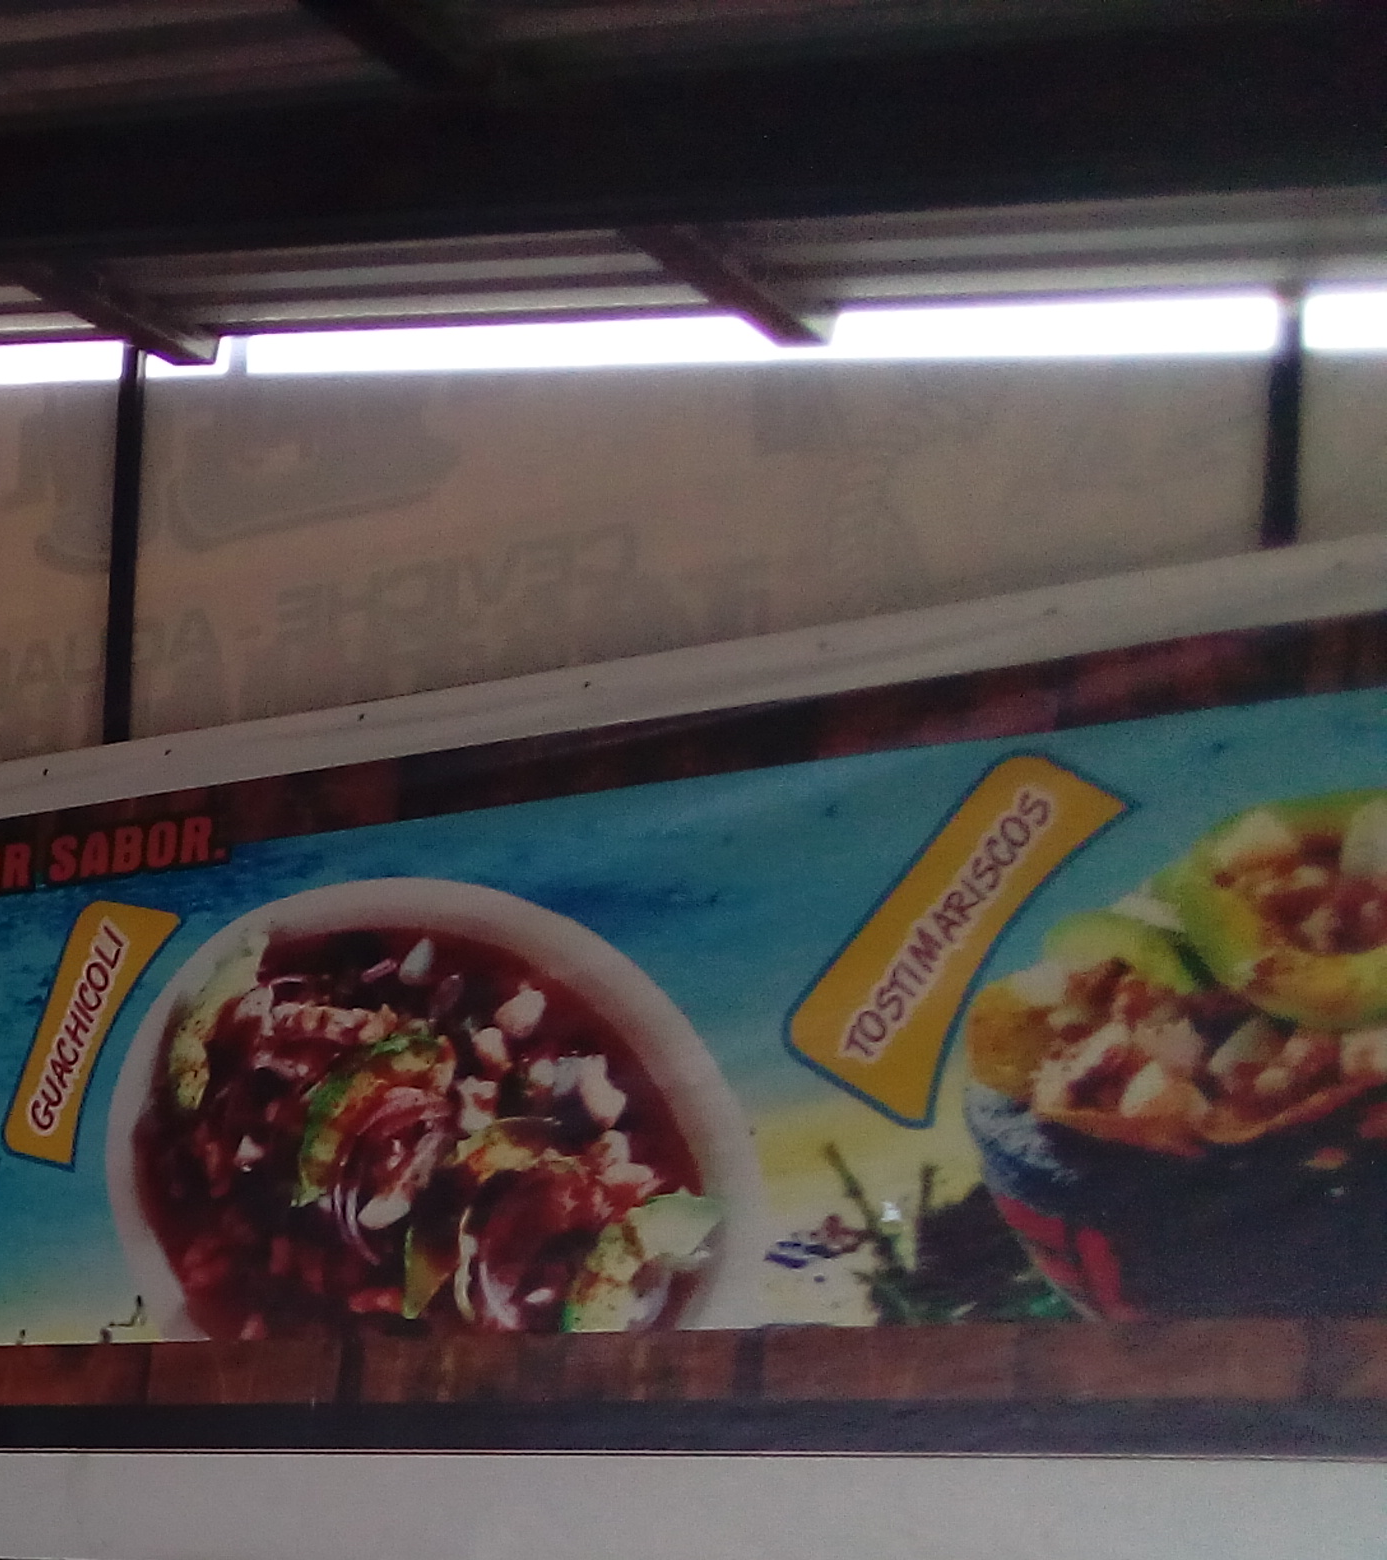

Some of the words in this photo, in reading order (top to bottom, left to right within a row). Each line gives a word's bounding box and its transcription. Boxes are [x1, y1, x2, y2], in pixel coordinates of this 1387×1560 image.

[49, 815, 225, 882] SABOR.
[842, 790, 1053, 1058] TOSTIMARISCOS
[30, 924, 125, 1131] GUACHICOLI
